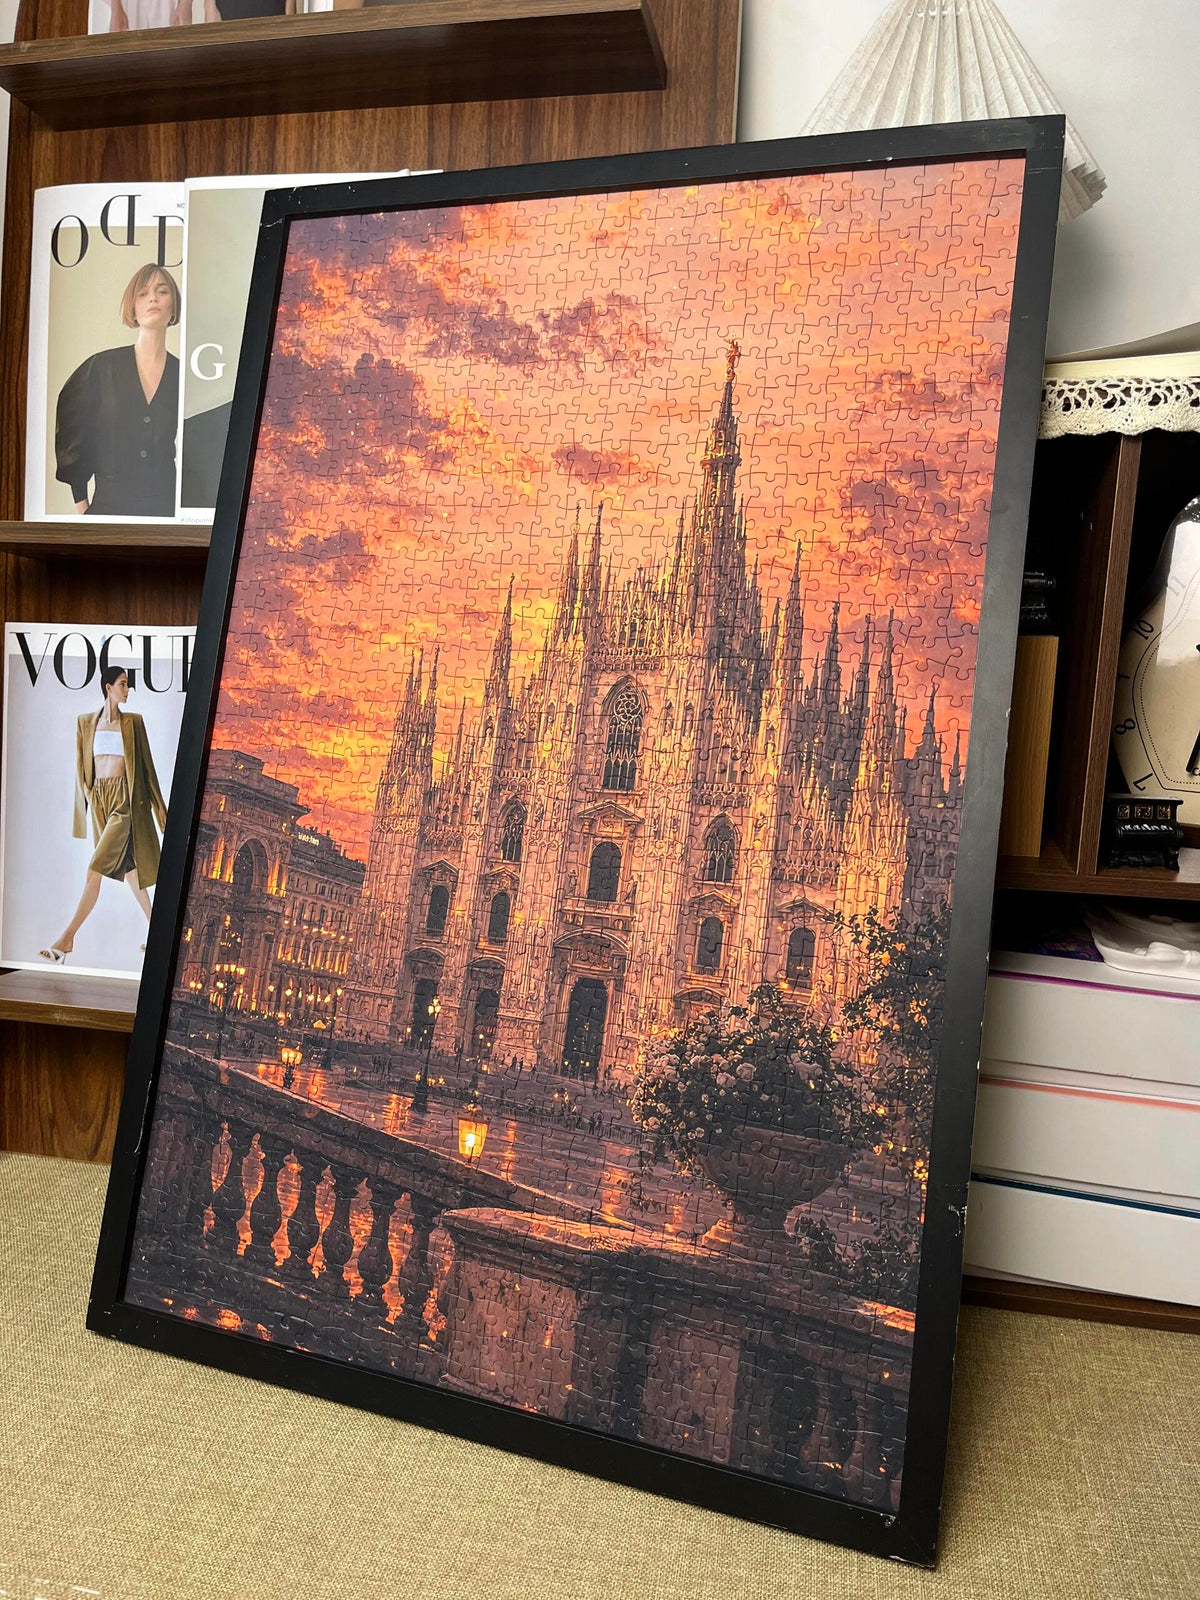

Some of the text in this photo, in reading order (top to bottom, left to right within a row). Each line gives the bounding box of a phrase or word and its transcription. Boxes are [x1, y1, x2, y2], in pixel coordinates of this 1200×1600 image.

[190, 343, 226, 380] G
[1132, 619, 1154, 640] 10
[1114, 718, 1136, 735] 8
[1133, 772, 1153, 791] 7
